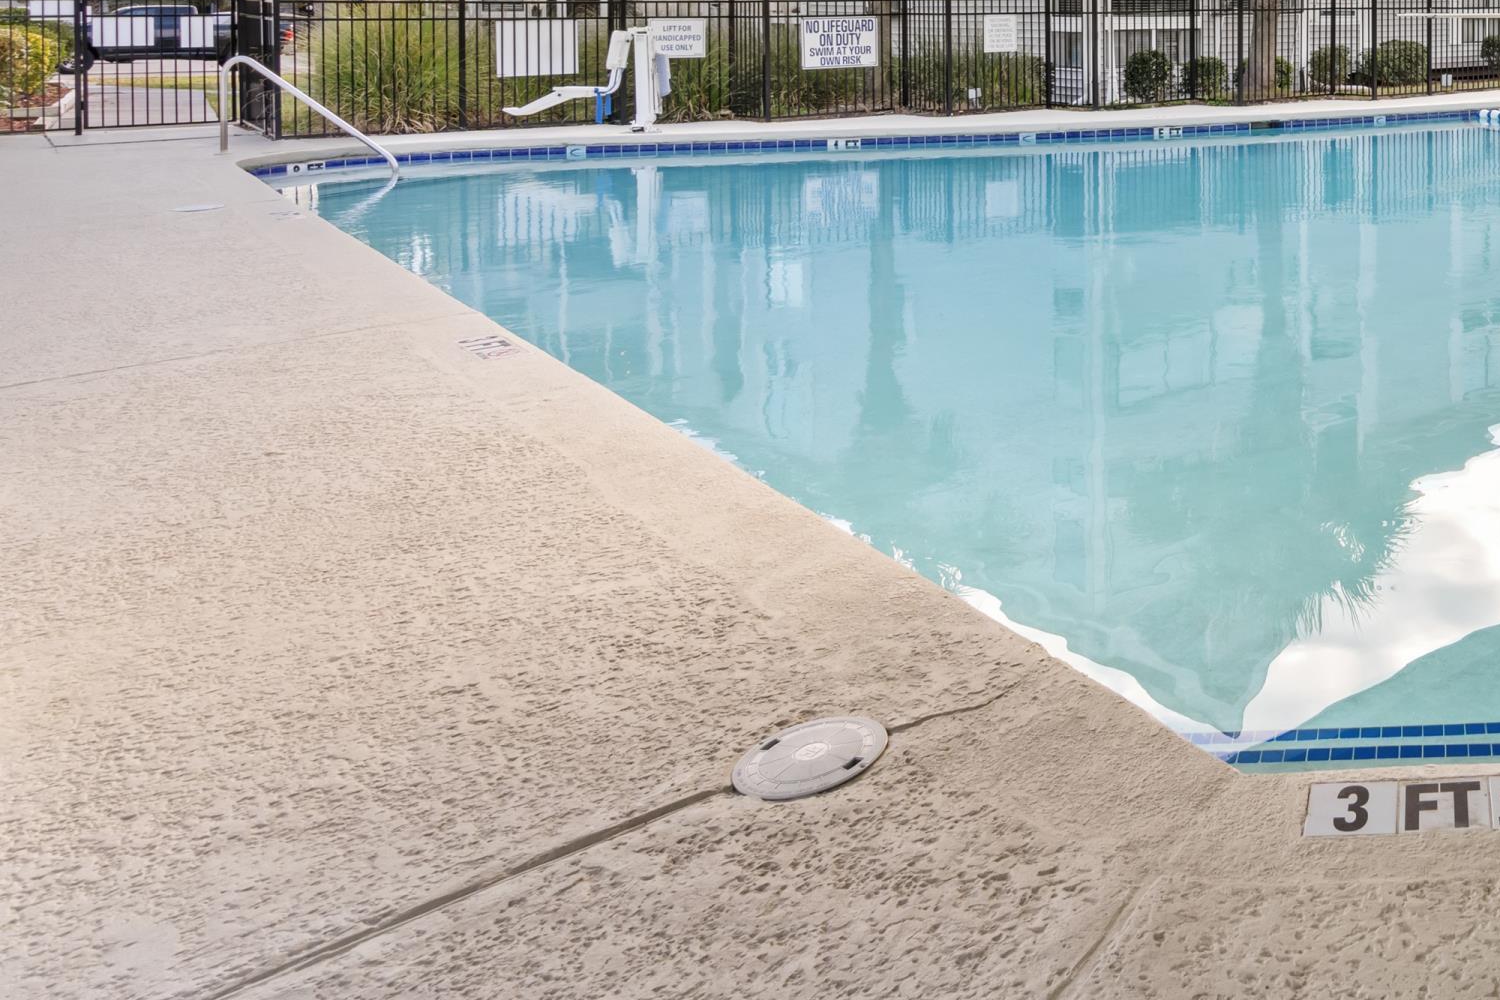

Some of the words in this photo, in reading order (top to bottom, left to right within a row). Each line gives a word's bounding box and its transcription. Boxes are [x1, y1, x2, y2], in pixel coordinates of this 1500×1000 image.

[806, 20, 820, 34] NO
[822, 19, 874, 32] LIFEGUARD
[820, 34, 833, 46] ON
[836, 32, 861, 46] DUTY
[810, 47, 834, 56] SWIM
[836, 46, 846, 56] AT
[848, 46, 872, 54] YOUR
[820, 56, 840, 66] OWN
[842, 56, 862, 64] RISK
[1332, 785, 1370, 832] 3
[1404, 780, 1481, 831] FT
